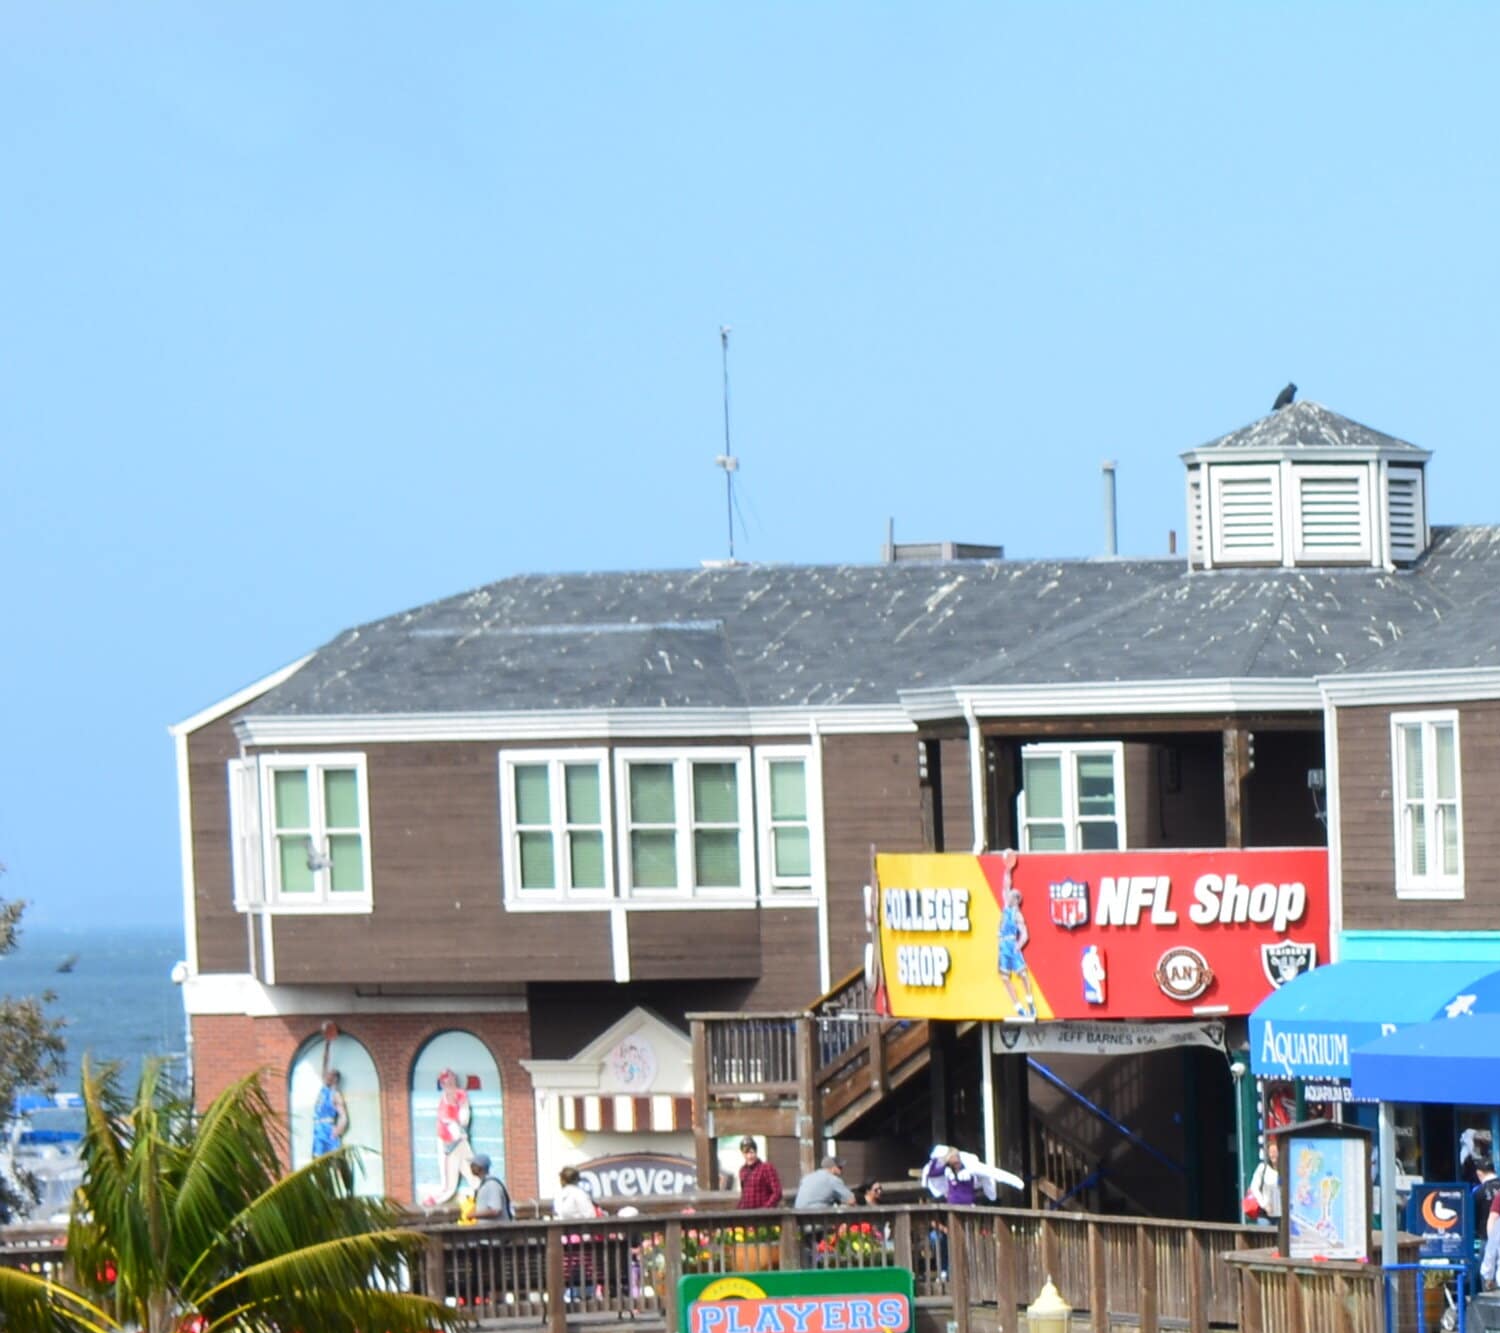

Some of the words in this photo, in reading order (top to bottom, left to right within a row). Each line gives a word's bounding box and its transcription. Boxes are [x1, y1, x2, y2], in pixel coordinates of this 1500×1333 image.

[884, 888, 970, 932] COLLEGE
[1095, 875, 1177, 926] NFL
[1189, 873, 1306, 932] Shop
[895, 945, 949, 987] SHOP
[1057, 1031, 1083, 1044] JEFF
[1086, 1031, 1133, 1046] BARNES
